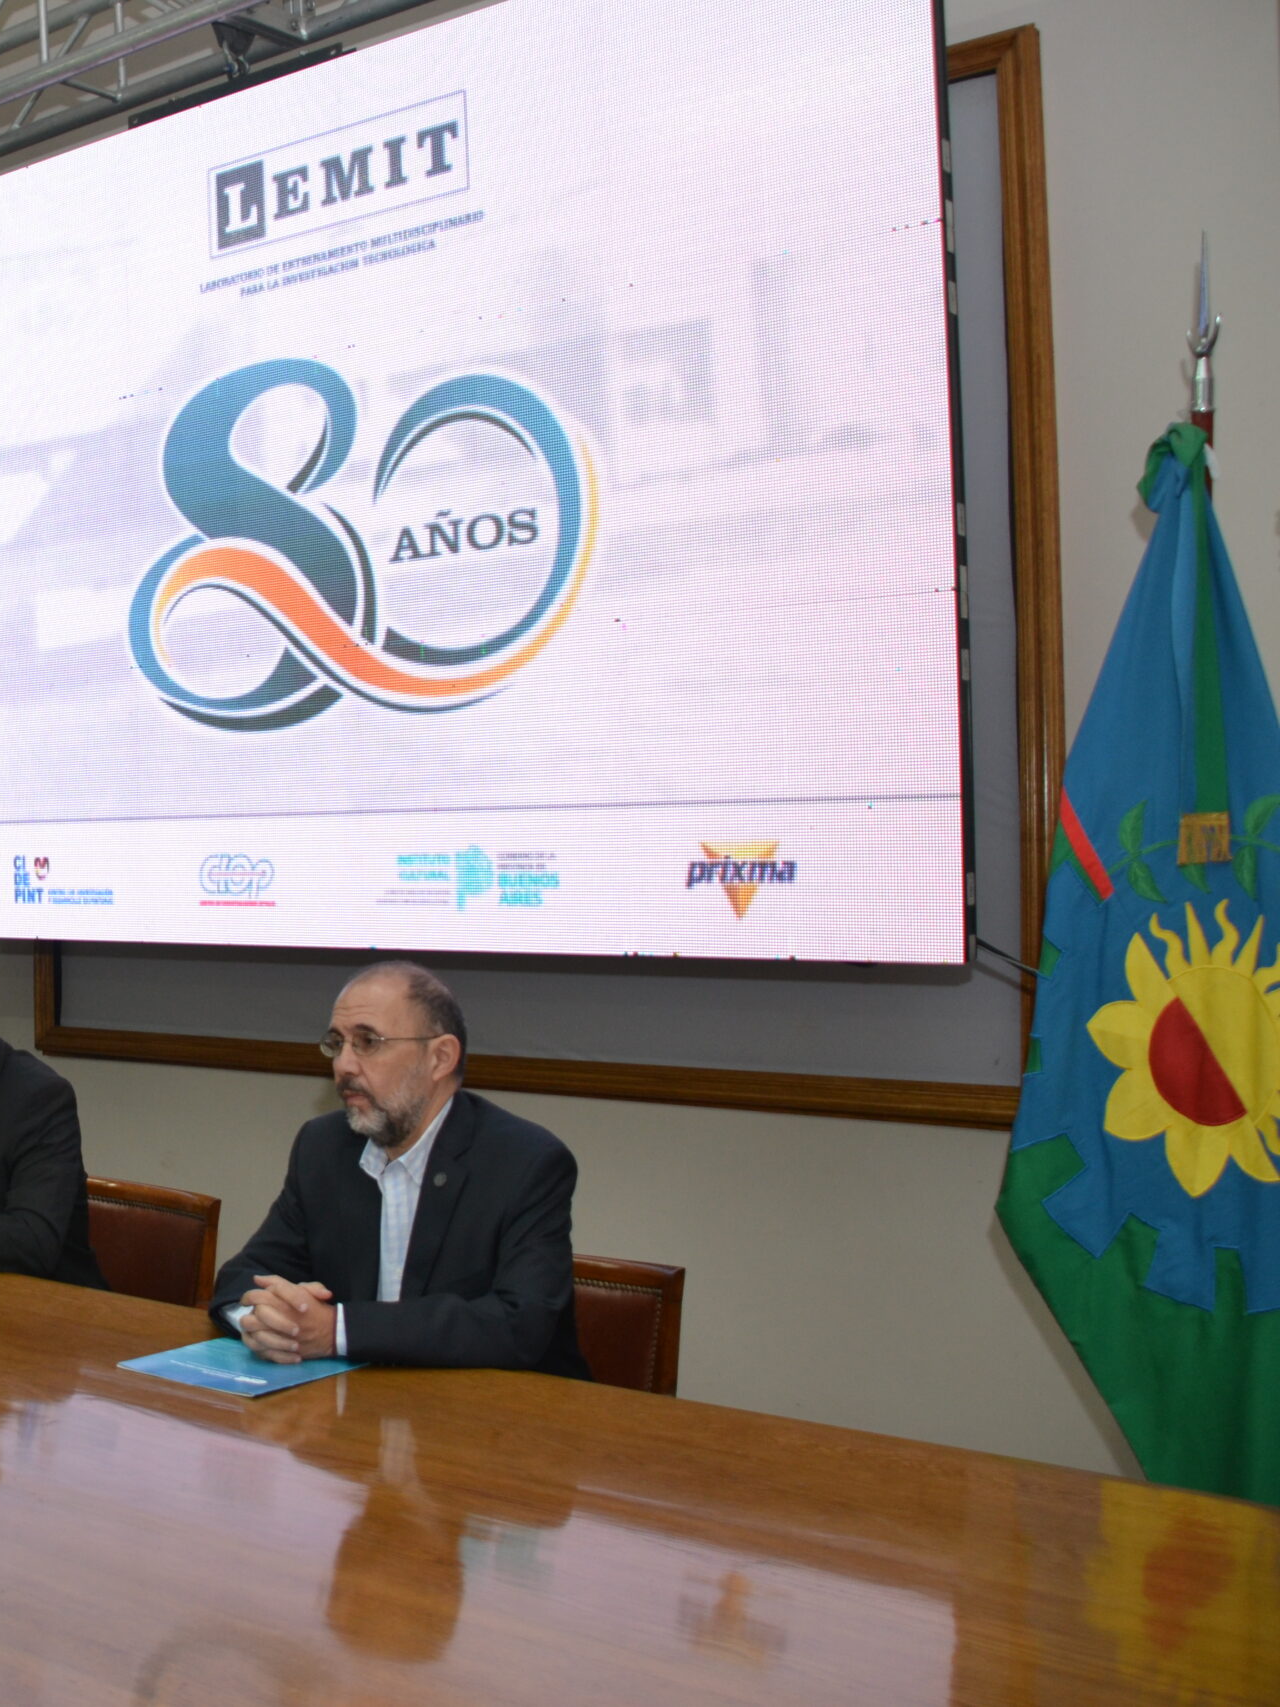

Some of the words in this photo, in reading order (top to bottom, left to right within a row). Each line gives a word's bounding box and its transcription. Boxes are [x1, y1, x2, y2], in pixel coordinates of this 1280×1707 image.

[222, 118, 460, 234] LEMIT
[200, 267, 264, 294] LABORATORIO
[266, 263, 280, 276] DE
[240, 283, 265, 298] PARA
[389, 508, 540, 564] AÑOS
